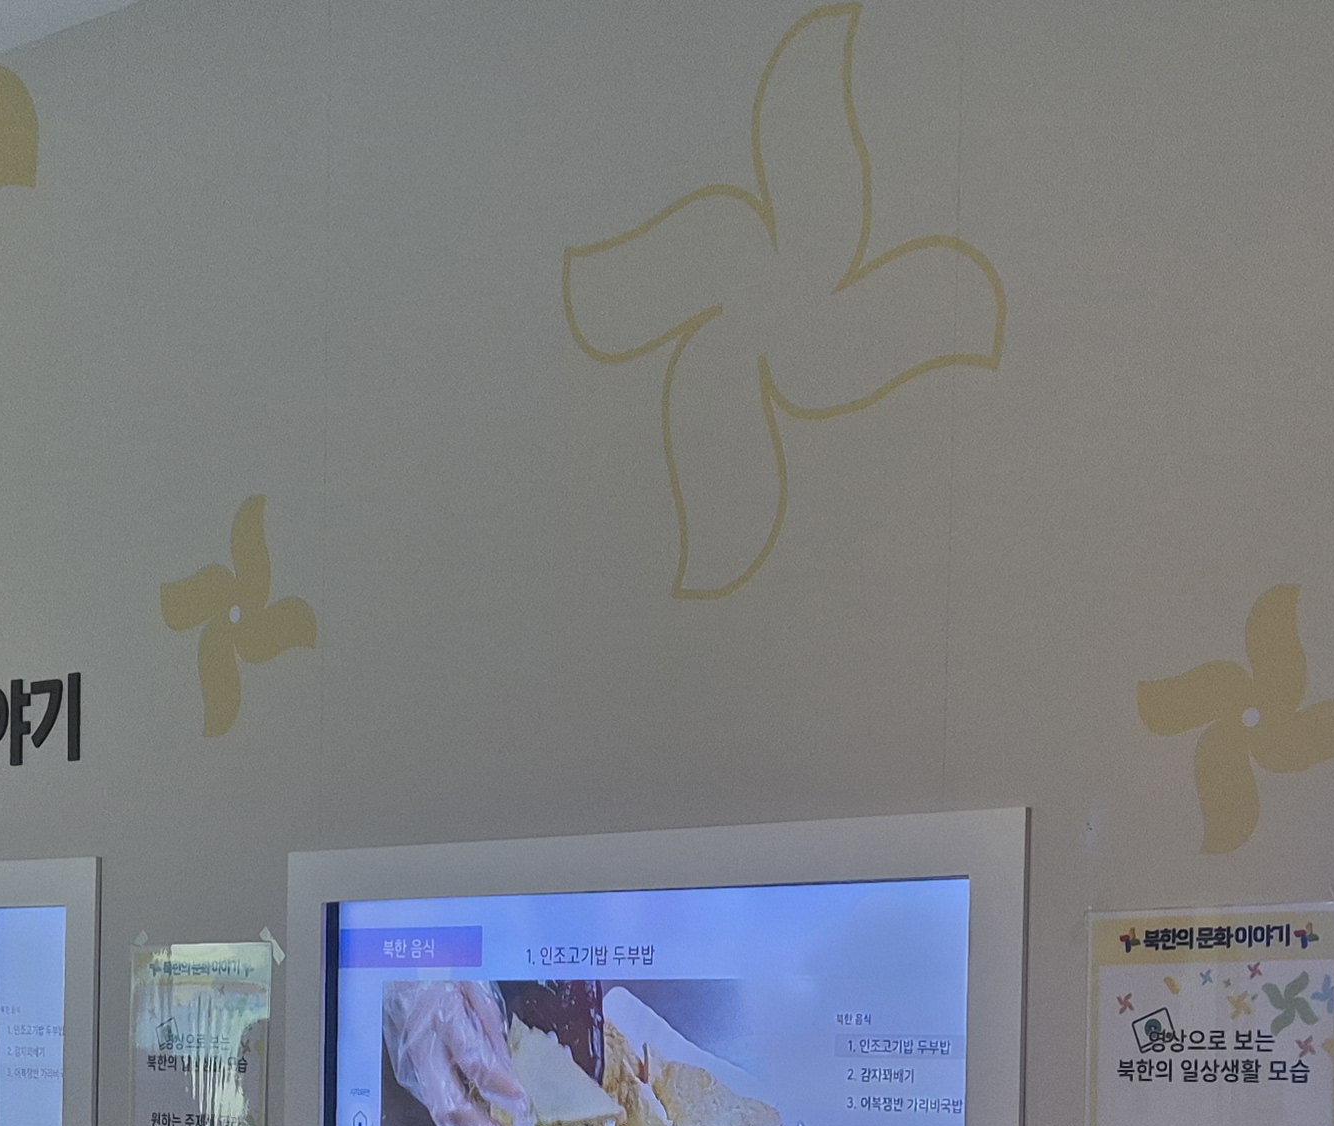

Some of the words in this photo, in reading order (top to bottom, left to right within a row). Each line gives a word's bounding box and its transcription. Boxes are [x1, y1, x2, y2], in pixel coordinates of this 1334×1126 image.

[382, 939, 407, 959] 북한
[410, 938, 435, 959] 음식
[1143, 926, 1193, 951] 북한의
[526, 948, 535, 966] 1.
[540, 945, 608, 966] 인조고기밥
[613, 944, 655, 966] 두부밥
[836, 1013, 852, 1026] 북한
[855, 1013, 872, 1026] 음식
[848, 1040, 856, 1053] 1.
[859, 1039, 914, 1055] 인조고기밥
[917, 1040, 951, 1055] 두부밥
[1149, 1029, 1227, 1053] 영상으로
[1233, 1029, 1275, 1052] 보는
[147, 1054, 177, 1072] 북한의
[1117, 1058, 1173, 1083] 북한의
[1180, 1058, 1262, 1083] 일상생활
[1268, 1059, 1311, 1084] 모습
[847, 1068, 857, 1081] 2.
[861, 1067, 915, 1084] 감자꽈배기
[847, 1096, 857, 1110] 3.
[860, 1095, 904, 1112] 어복쟁반
[907, 1097, 964, 1114] 가리비국밥
